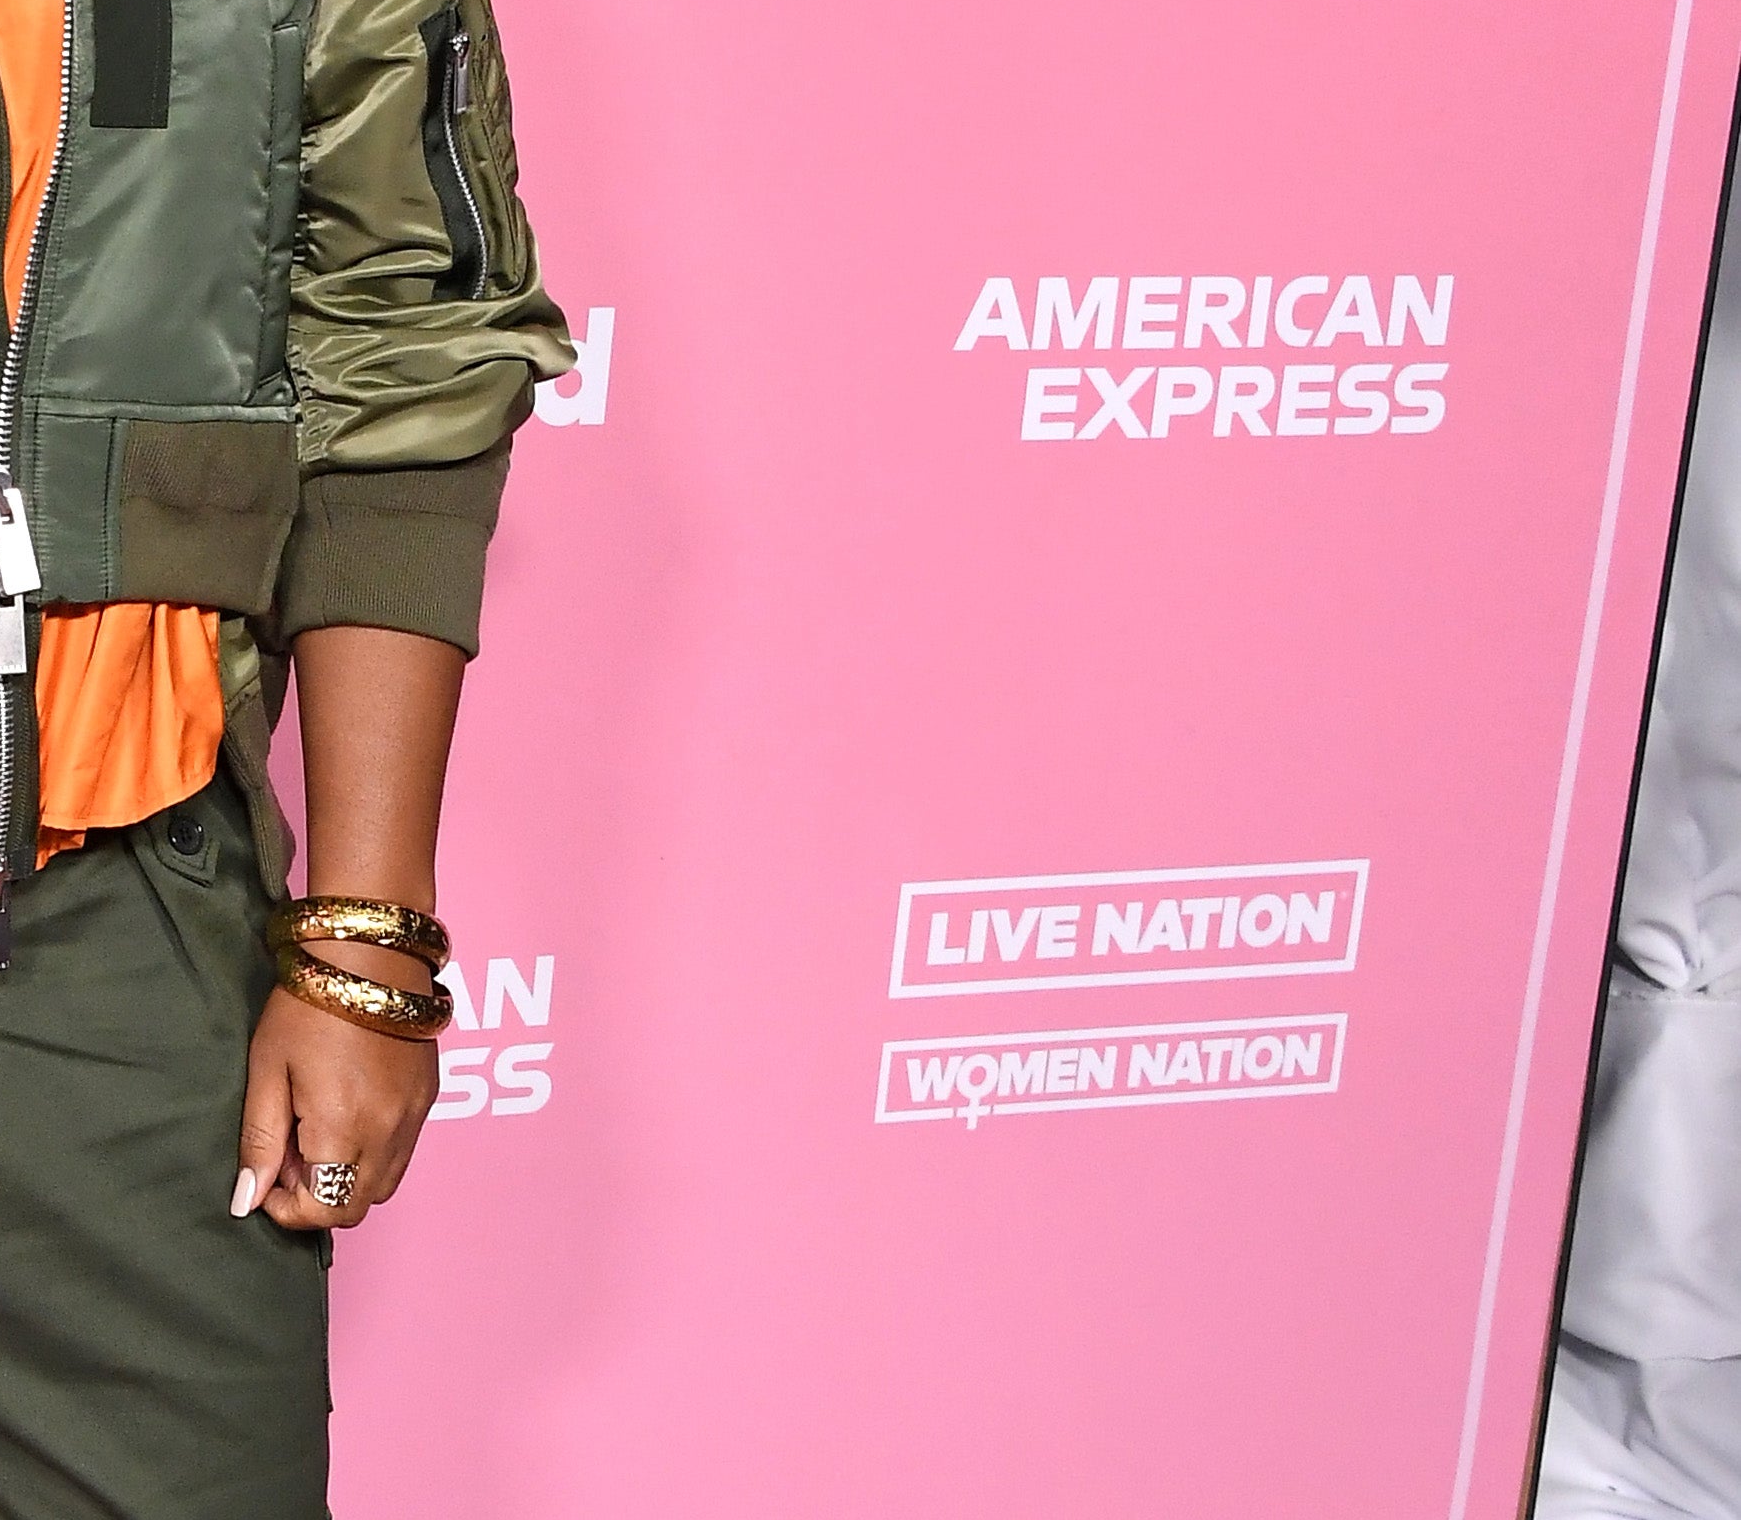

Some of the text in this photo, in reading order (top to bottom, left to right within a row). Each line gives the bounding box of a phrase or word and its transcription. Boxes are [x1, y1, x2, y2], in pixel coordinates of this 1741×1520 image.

[954, 274, 1455, 351] AMERICAN
[1020, 363, 1450, 441] EXPRESS
[926, 890, 1336, 966] LIVE NATION
[906, 1033, 1323, 1113] WOMEN NATION
